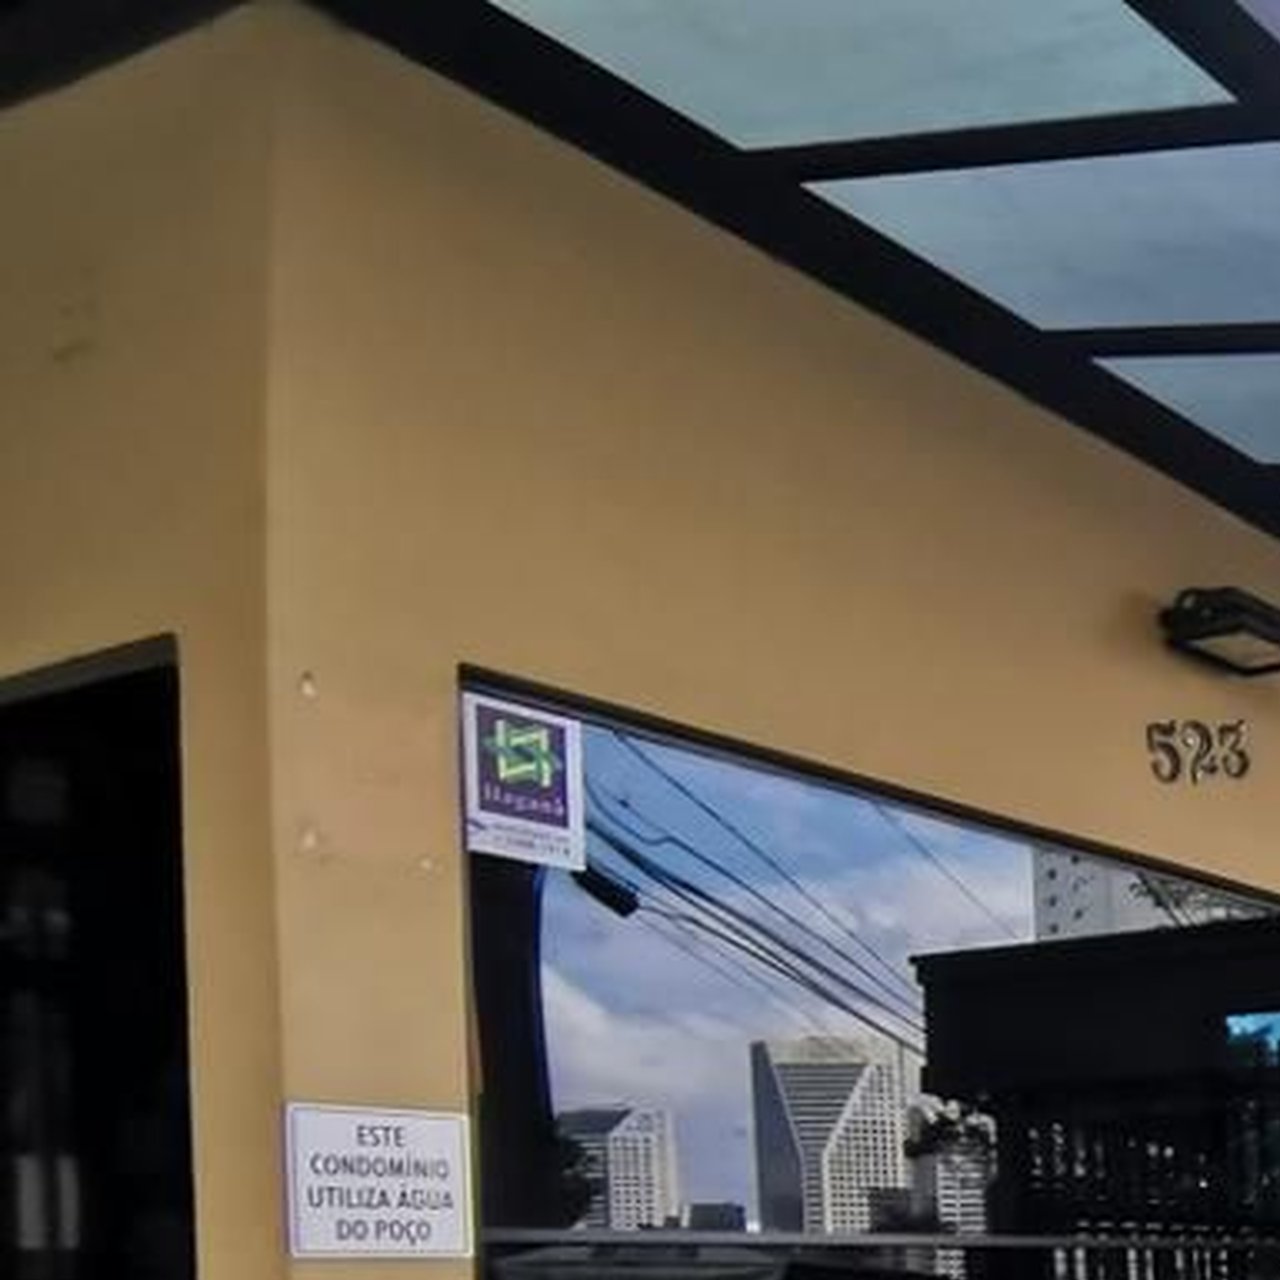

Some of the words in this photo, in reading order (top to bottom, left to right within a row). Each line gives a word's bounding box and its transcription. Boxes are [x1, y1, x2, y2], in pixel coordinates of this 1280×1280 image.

[1146, 719, 1250, 785] 523
[356, 1125, 406, 1148] ESTE
[309, 1153, 450, 1179] CONDOMÍNIO
[307, 1186, 391, 1210] UTILIZA
[397, 1182, 454, 1210] ÁGUA
[336, 1219, 369, 1241] DO
[375, 1219, 432, 1246] POÇO
